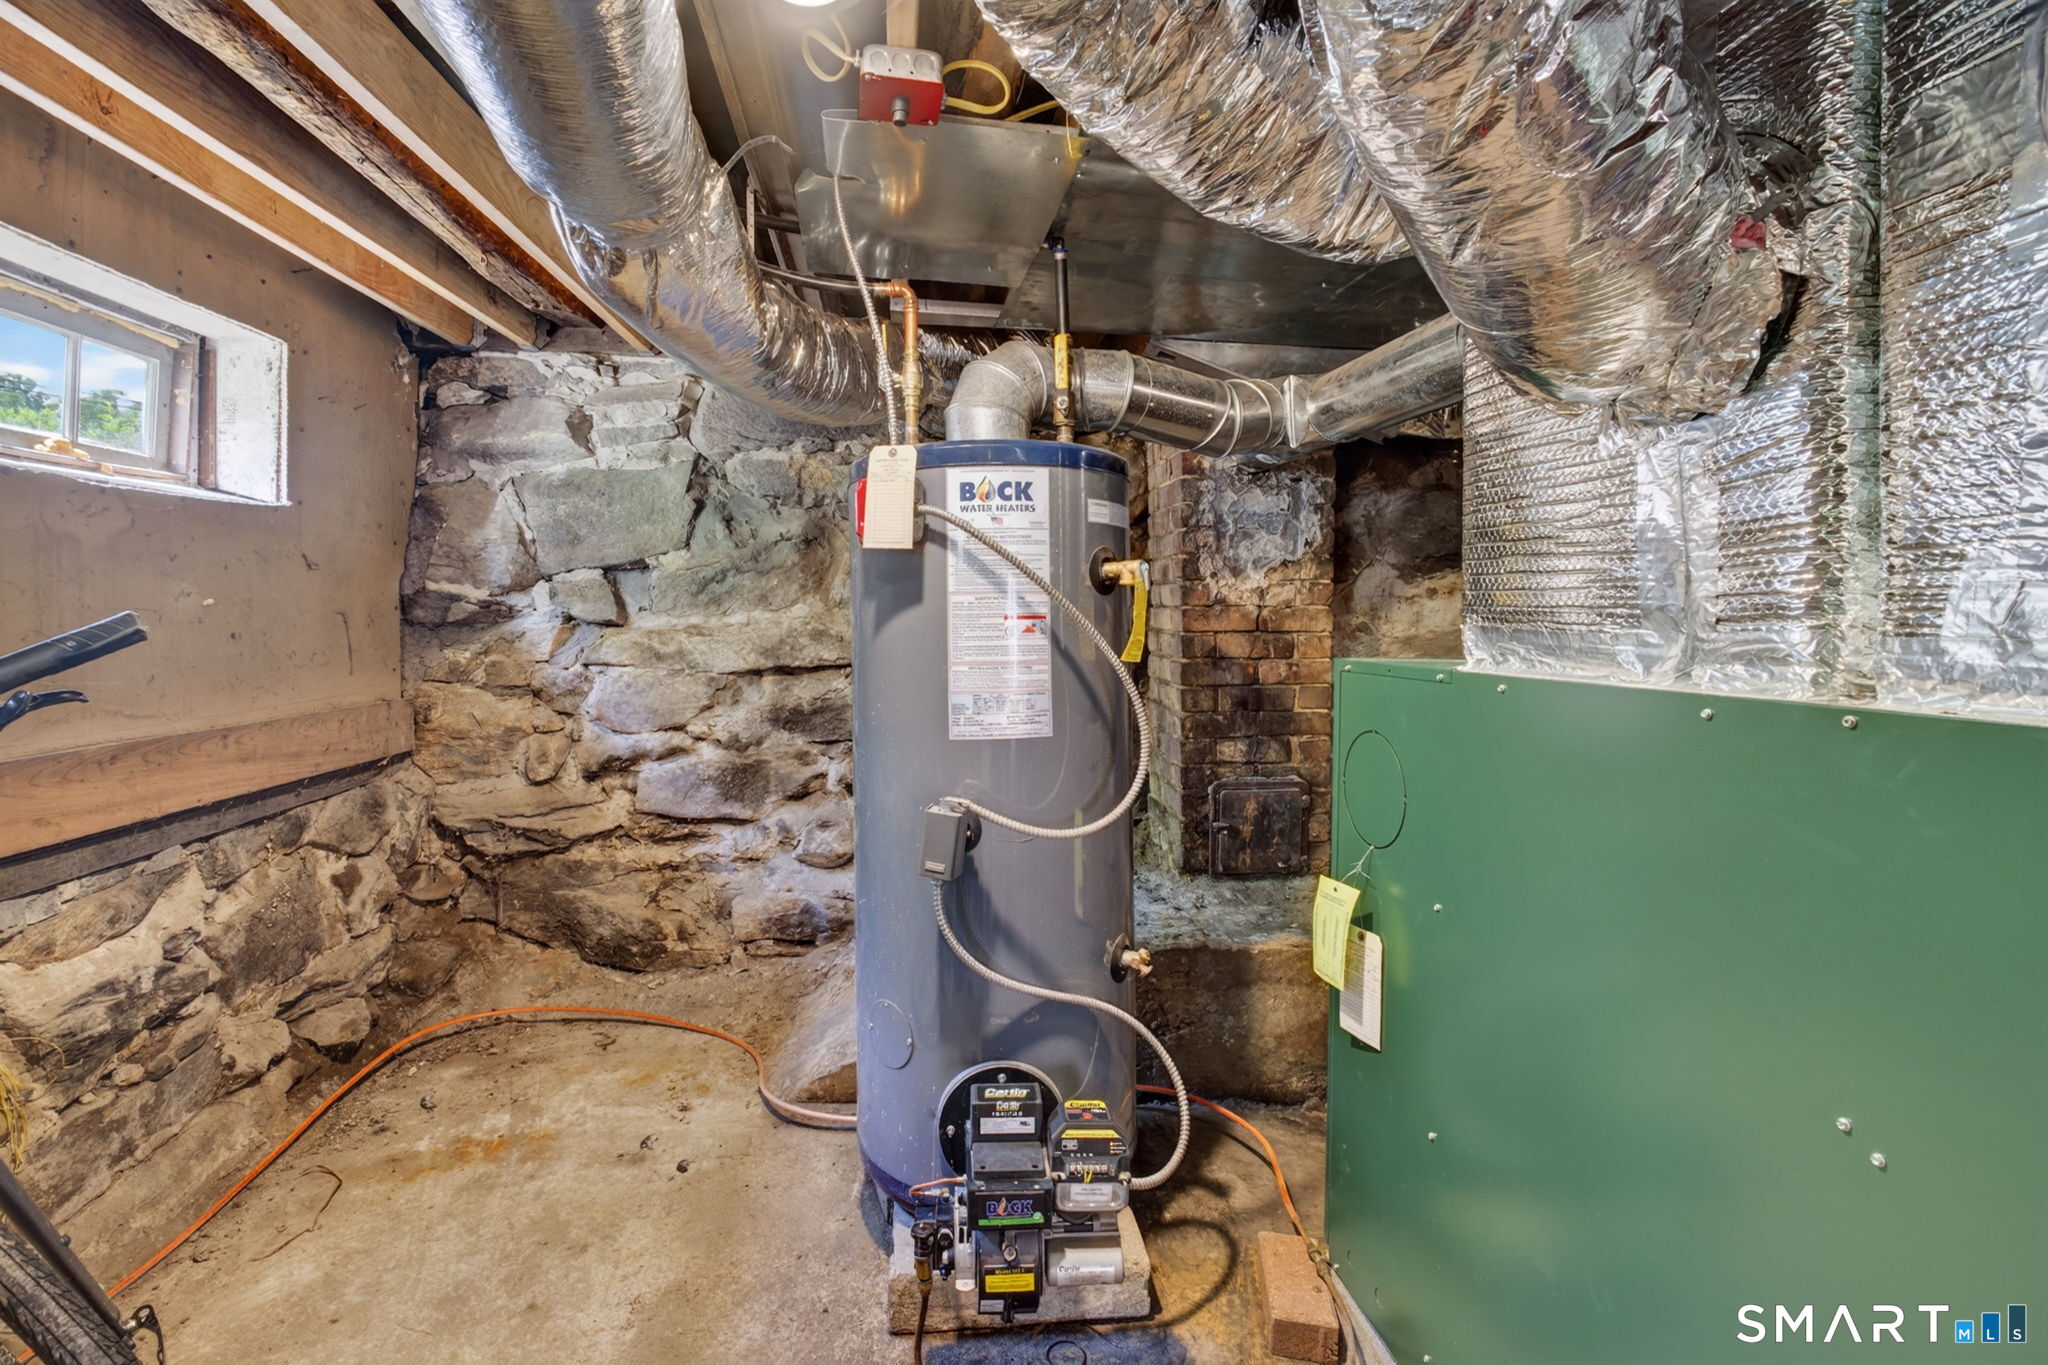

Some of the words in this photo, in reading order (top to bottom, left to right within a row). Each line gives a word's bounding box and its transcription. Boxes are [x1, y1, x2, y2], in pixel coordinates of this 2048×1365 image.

[960, 475, 1034, 502] BOCK
[960, 504, 993, 513] WATER
[996, 504, 1036, 513] HEATERS
[986, 1197, 1034, 1217] BOCK
